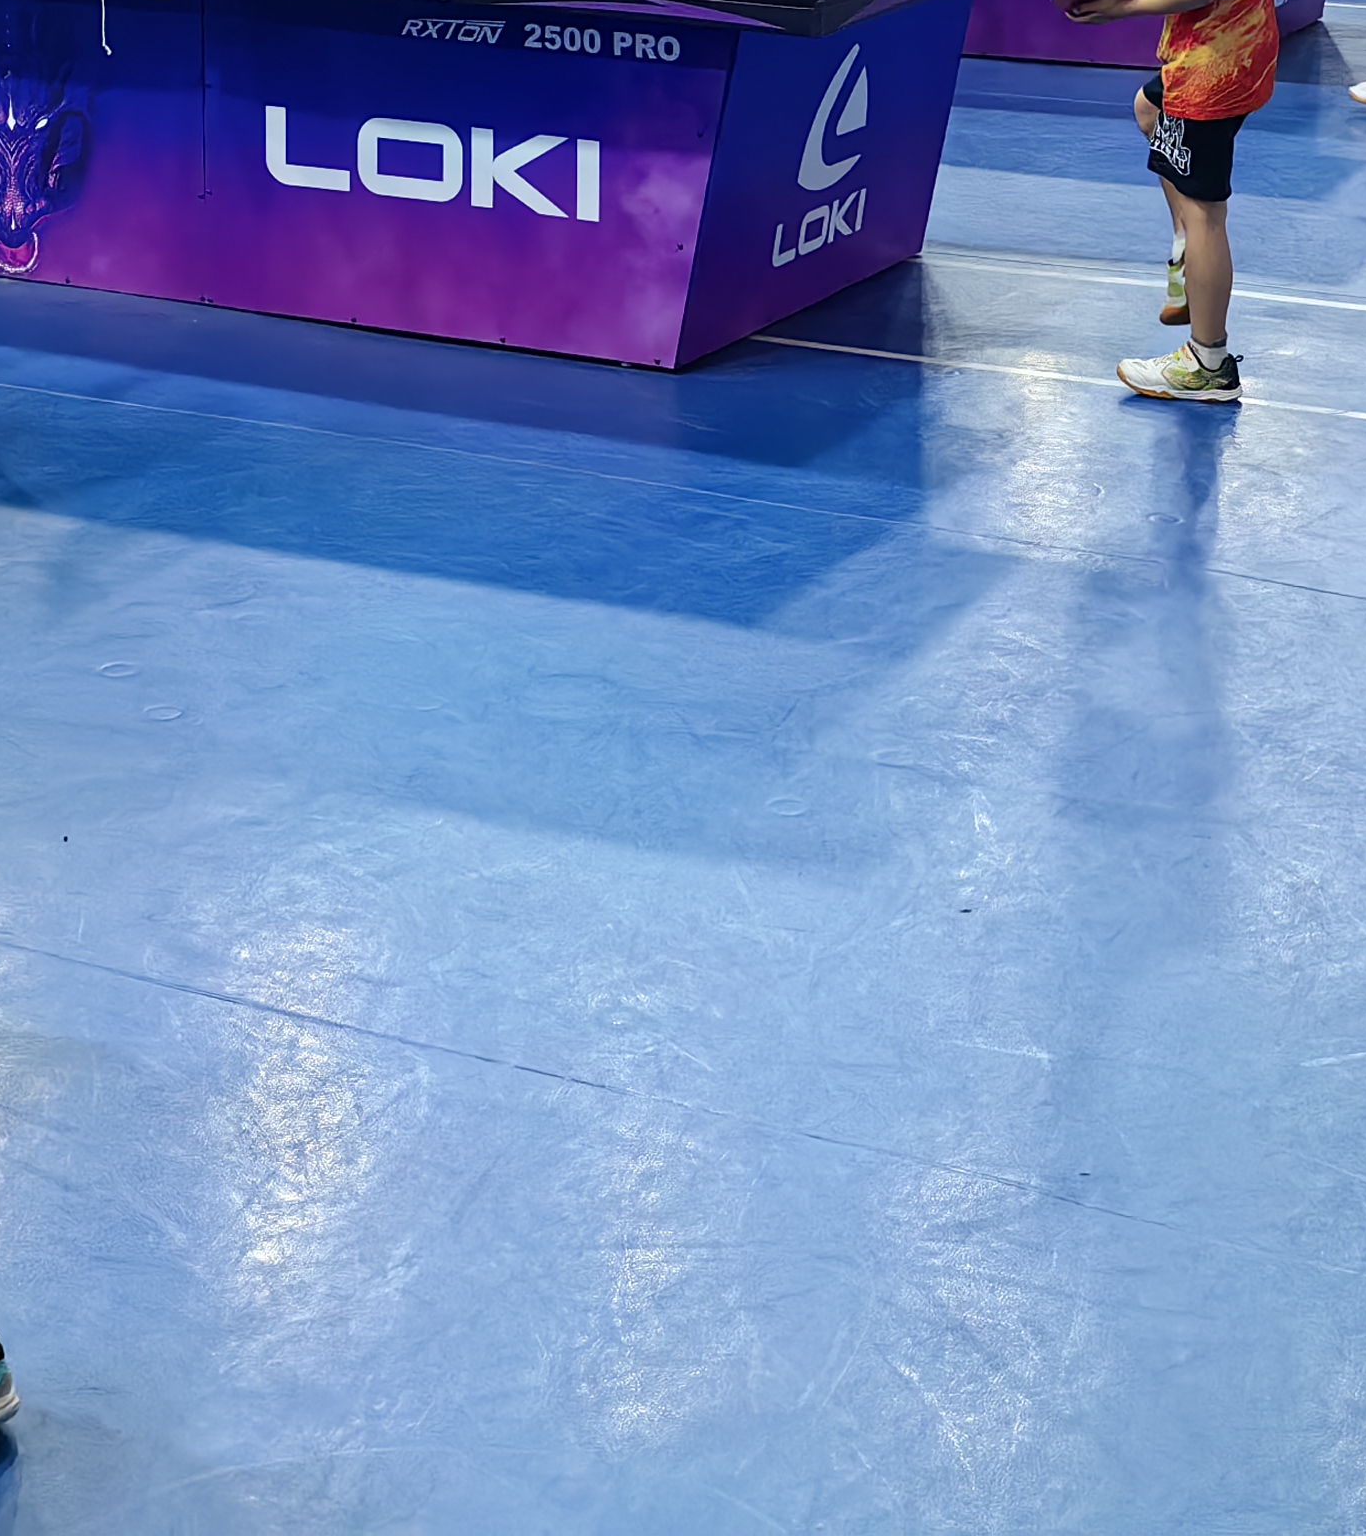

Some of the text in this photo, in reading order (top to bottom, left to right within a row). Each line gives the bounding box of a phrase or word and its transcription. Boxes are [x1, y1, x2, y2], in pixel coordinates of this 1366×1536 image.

[400, 18, 681, 62] RXTON 2500 PRO
[265, 104, 600, 222] LOKI
[771, 187, 867, 268] LOKI
